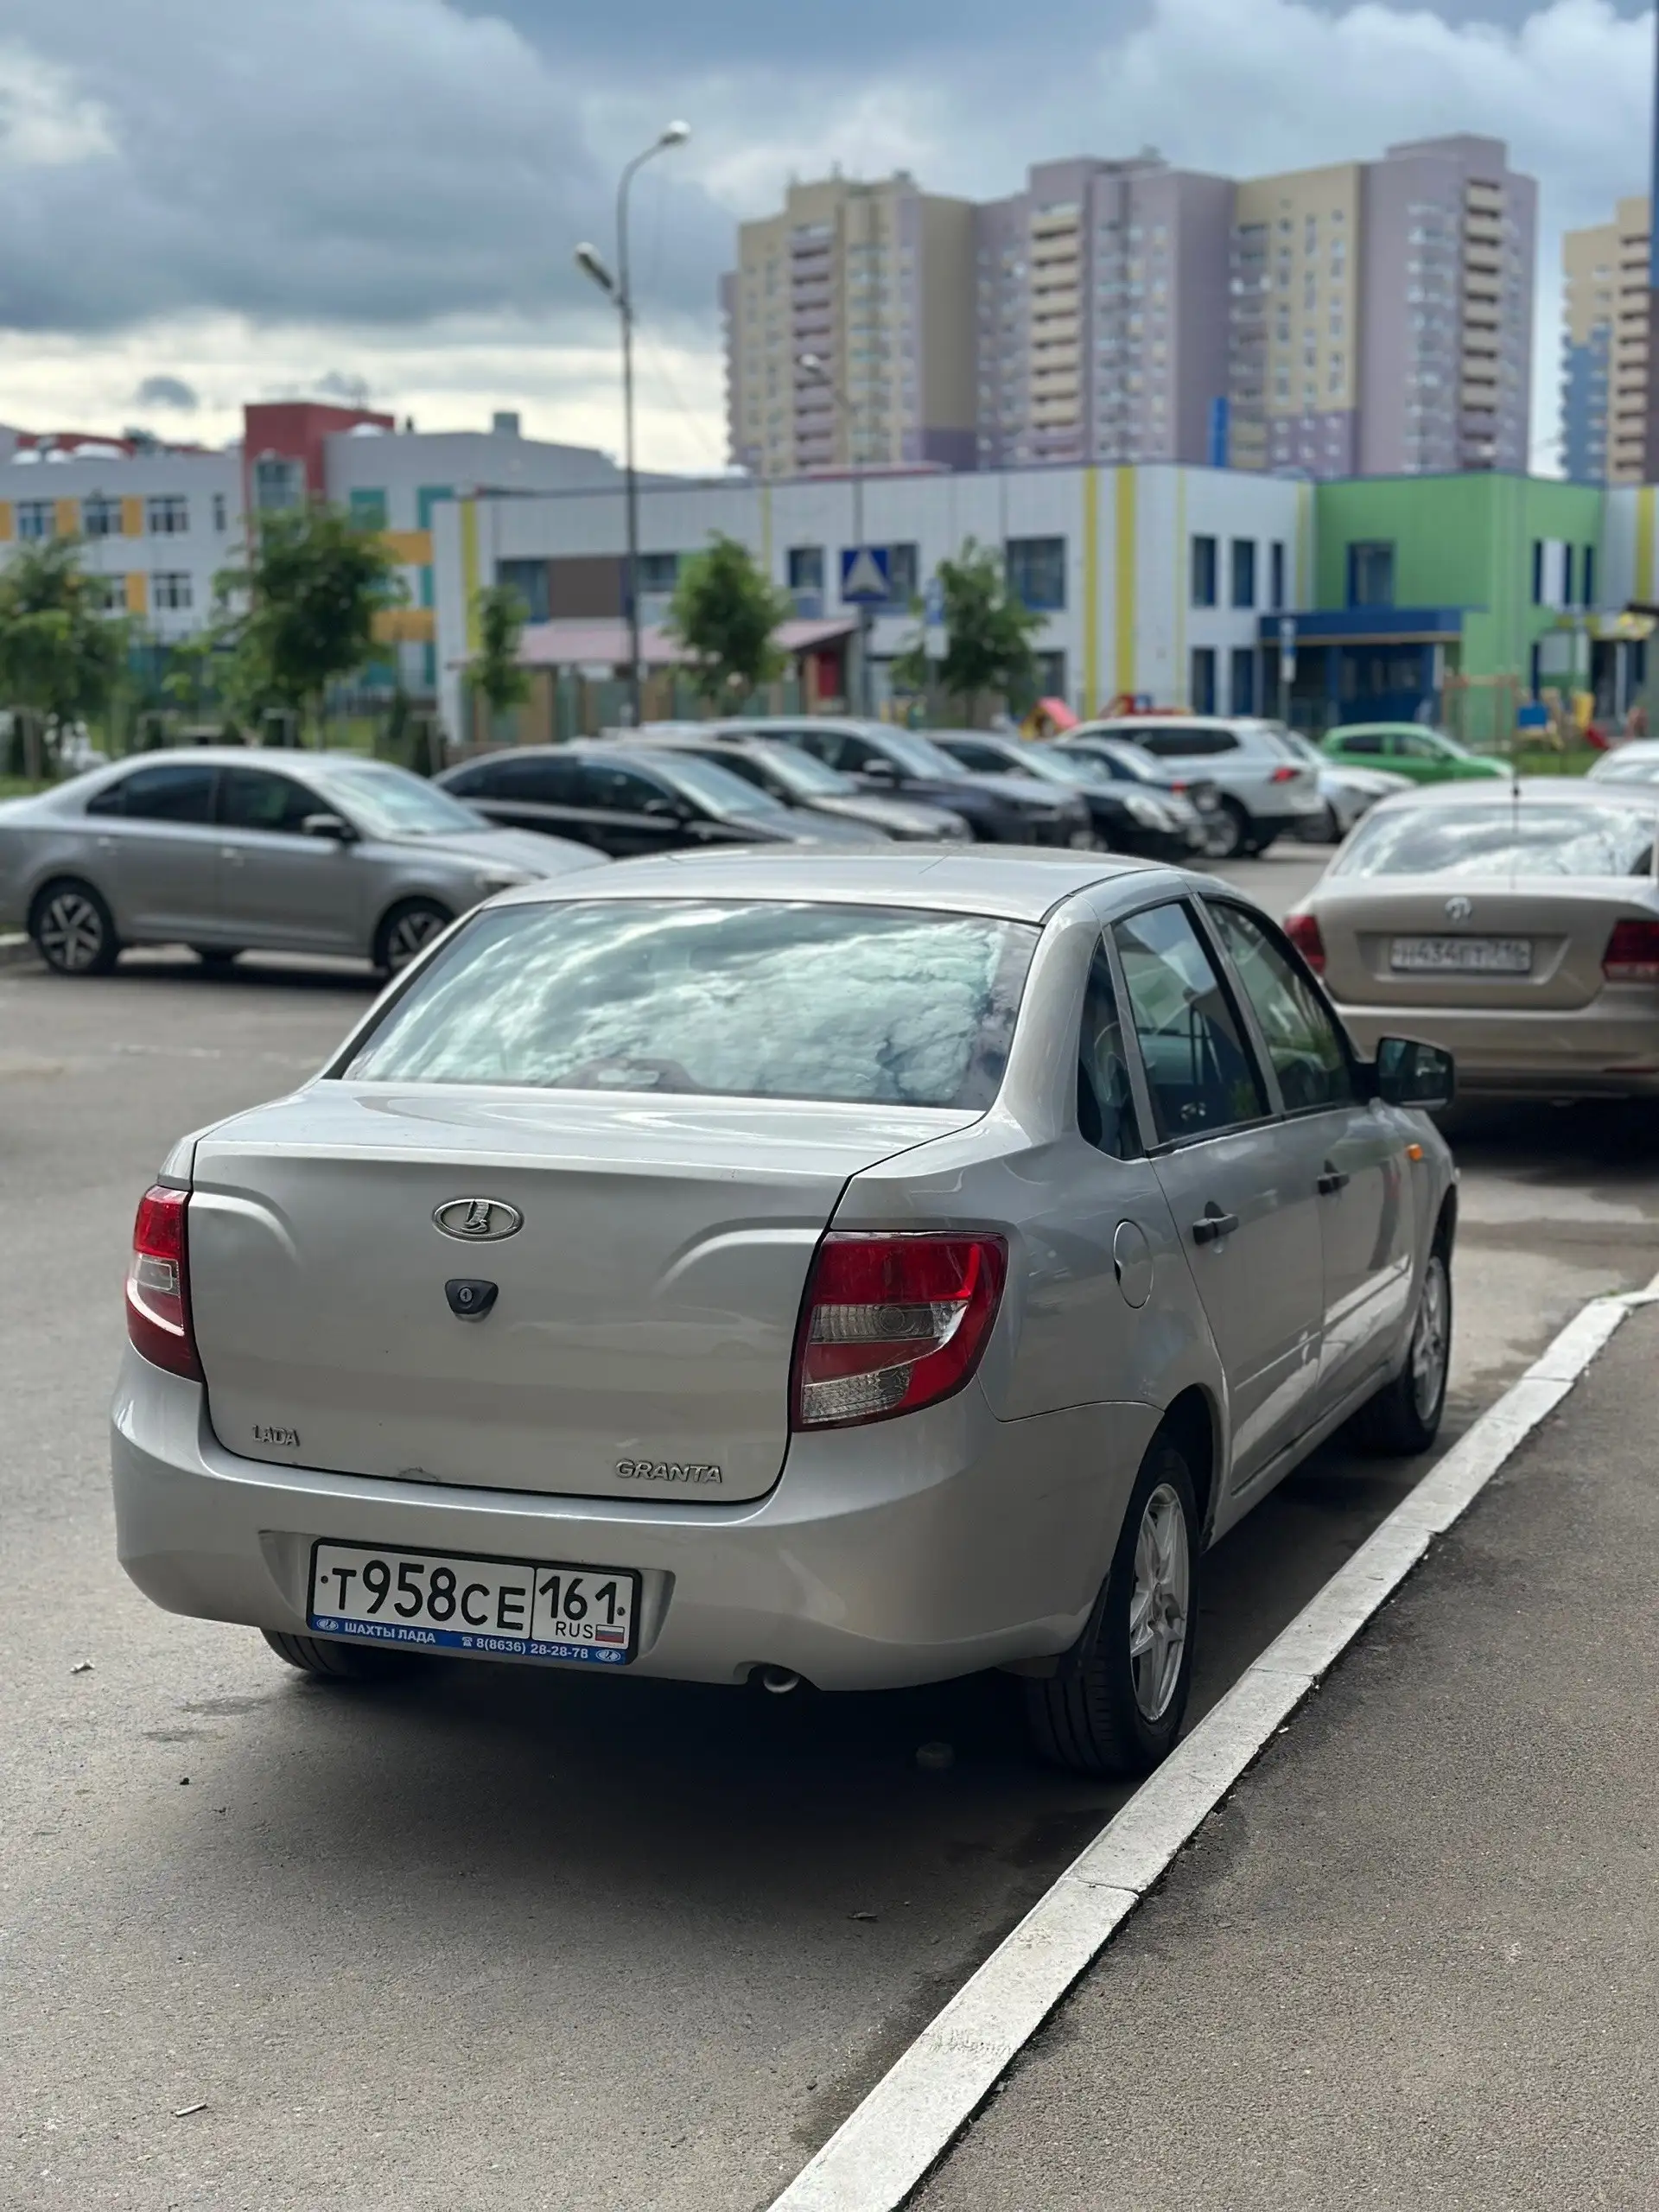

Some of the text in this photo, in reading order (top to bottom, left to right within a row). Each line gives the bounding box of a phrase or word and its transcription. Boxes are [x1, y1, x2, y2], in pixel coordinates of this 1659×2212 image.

[252, 1425, 301, 1446] LADA
[615, 1459, 722, 1484] GRANTA
[538, 1575, 617, 1624] 161
[345, 1622, 436, 1643] ШАХТЫ ЛАДА
[556, 1620, 594, 1640] RUS
[476, 1637, 588, 1659] 8(8636) 28-28-78
